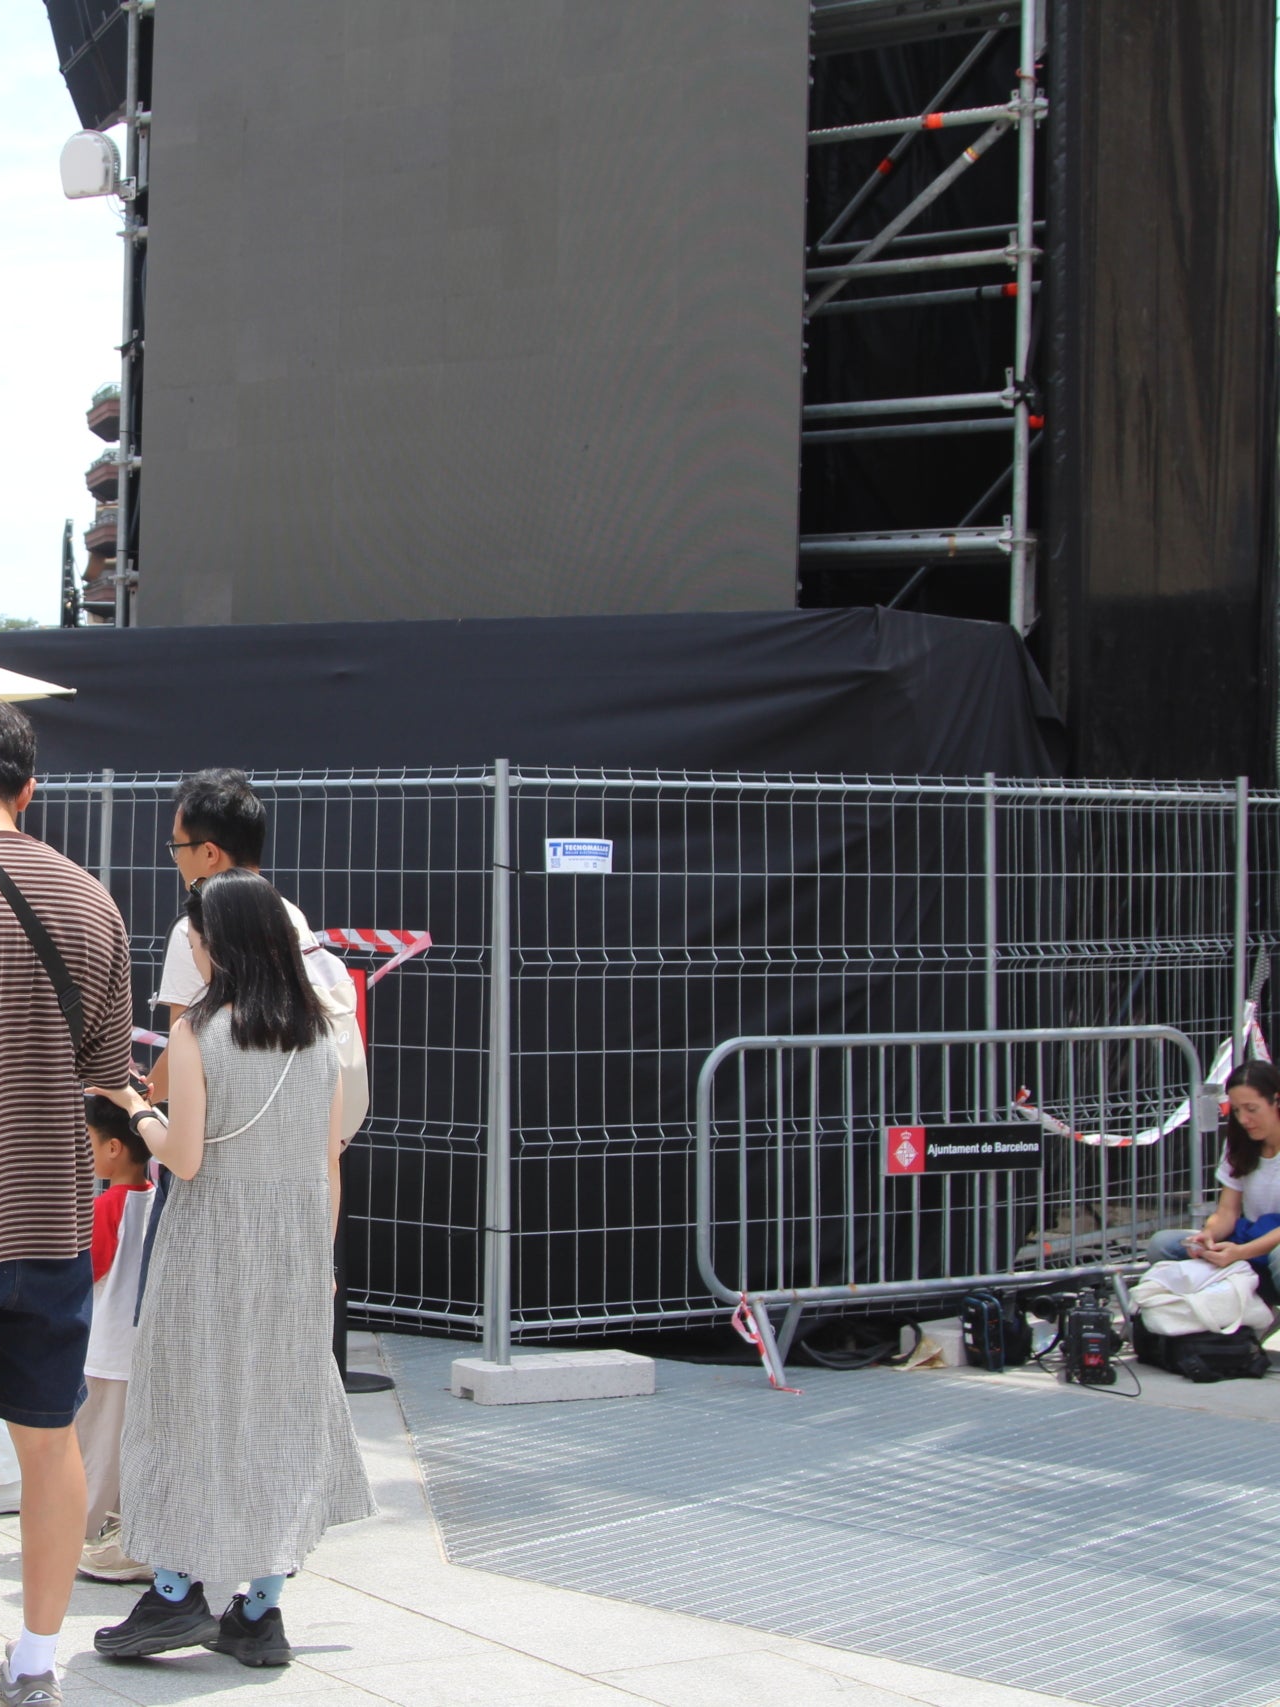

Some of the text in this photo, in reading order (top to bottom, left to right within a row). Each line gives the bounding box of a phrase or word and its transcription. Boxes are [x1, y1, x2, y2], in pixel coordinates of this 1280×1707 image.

[927, 1141, 1040, 1158] Ajuntament de Barcelona
